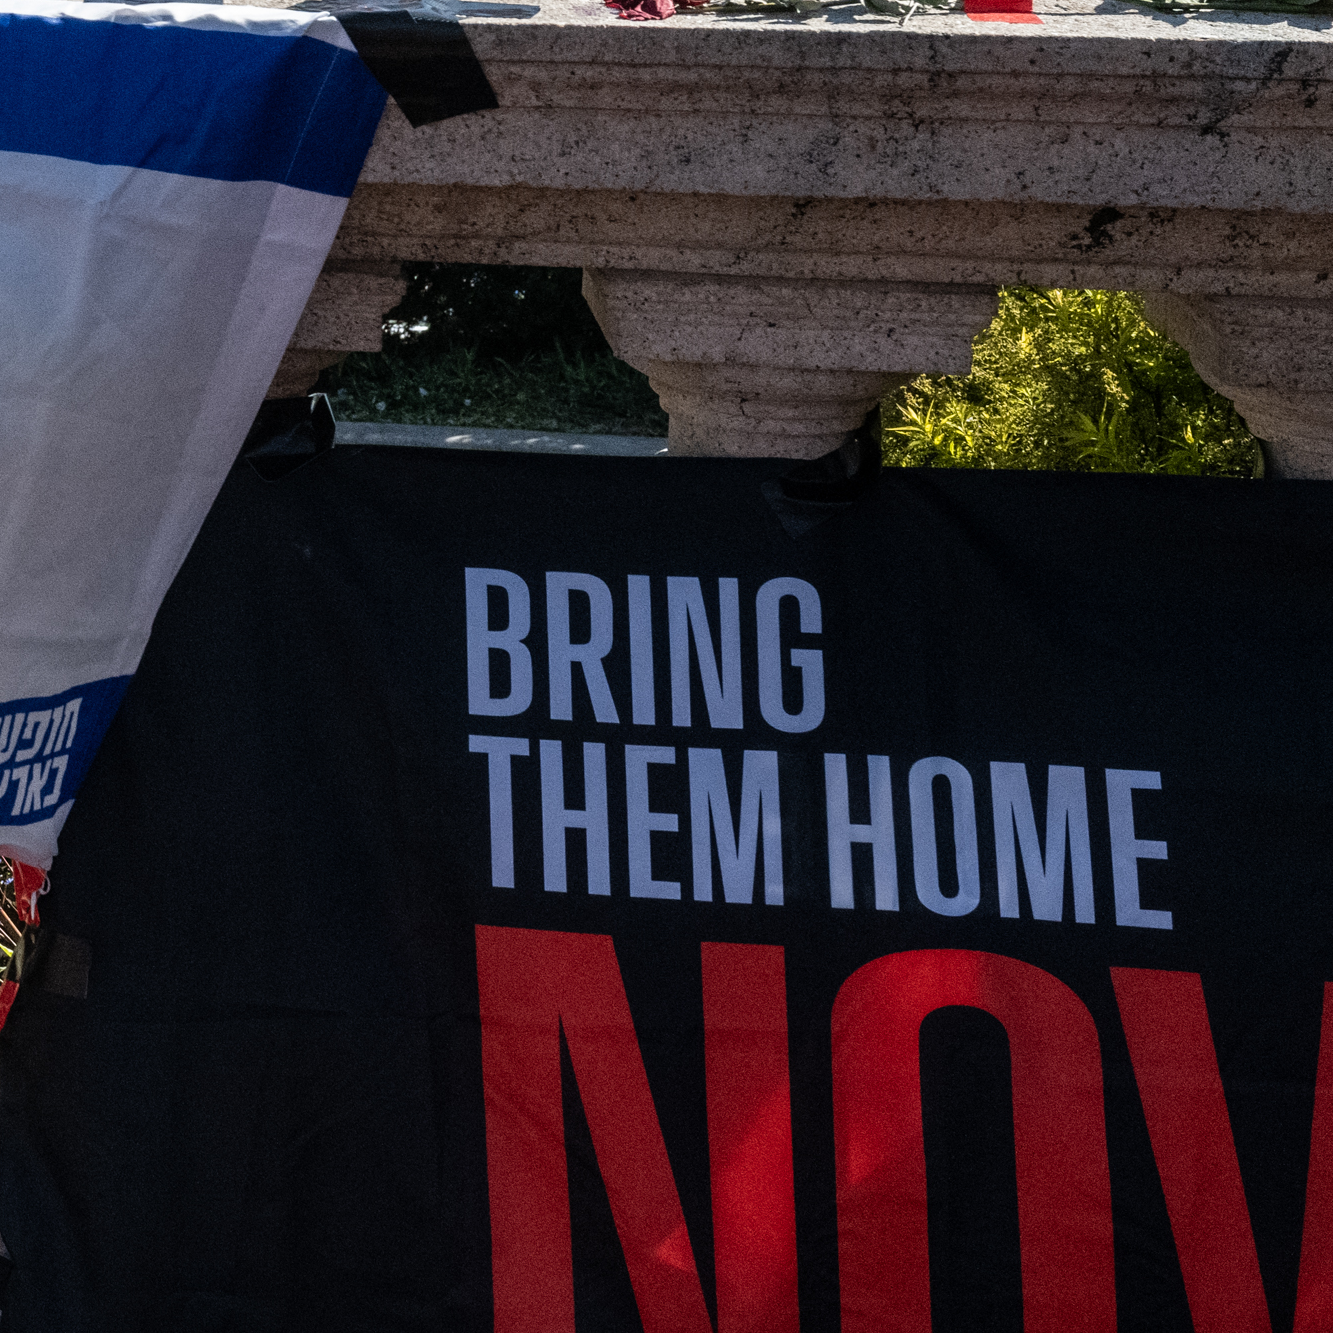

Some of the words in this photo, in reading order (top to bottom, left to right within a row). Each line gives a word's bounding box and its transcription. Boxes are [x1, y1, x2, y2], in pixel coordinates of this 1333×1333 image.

[464, 566, 827, 734] BRING
[468, 734, 785, 906] THEM
[823, 753, 1174, 930] HOME
